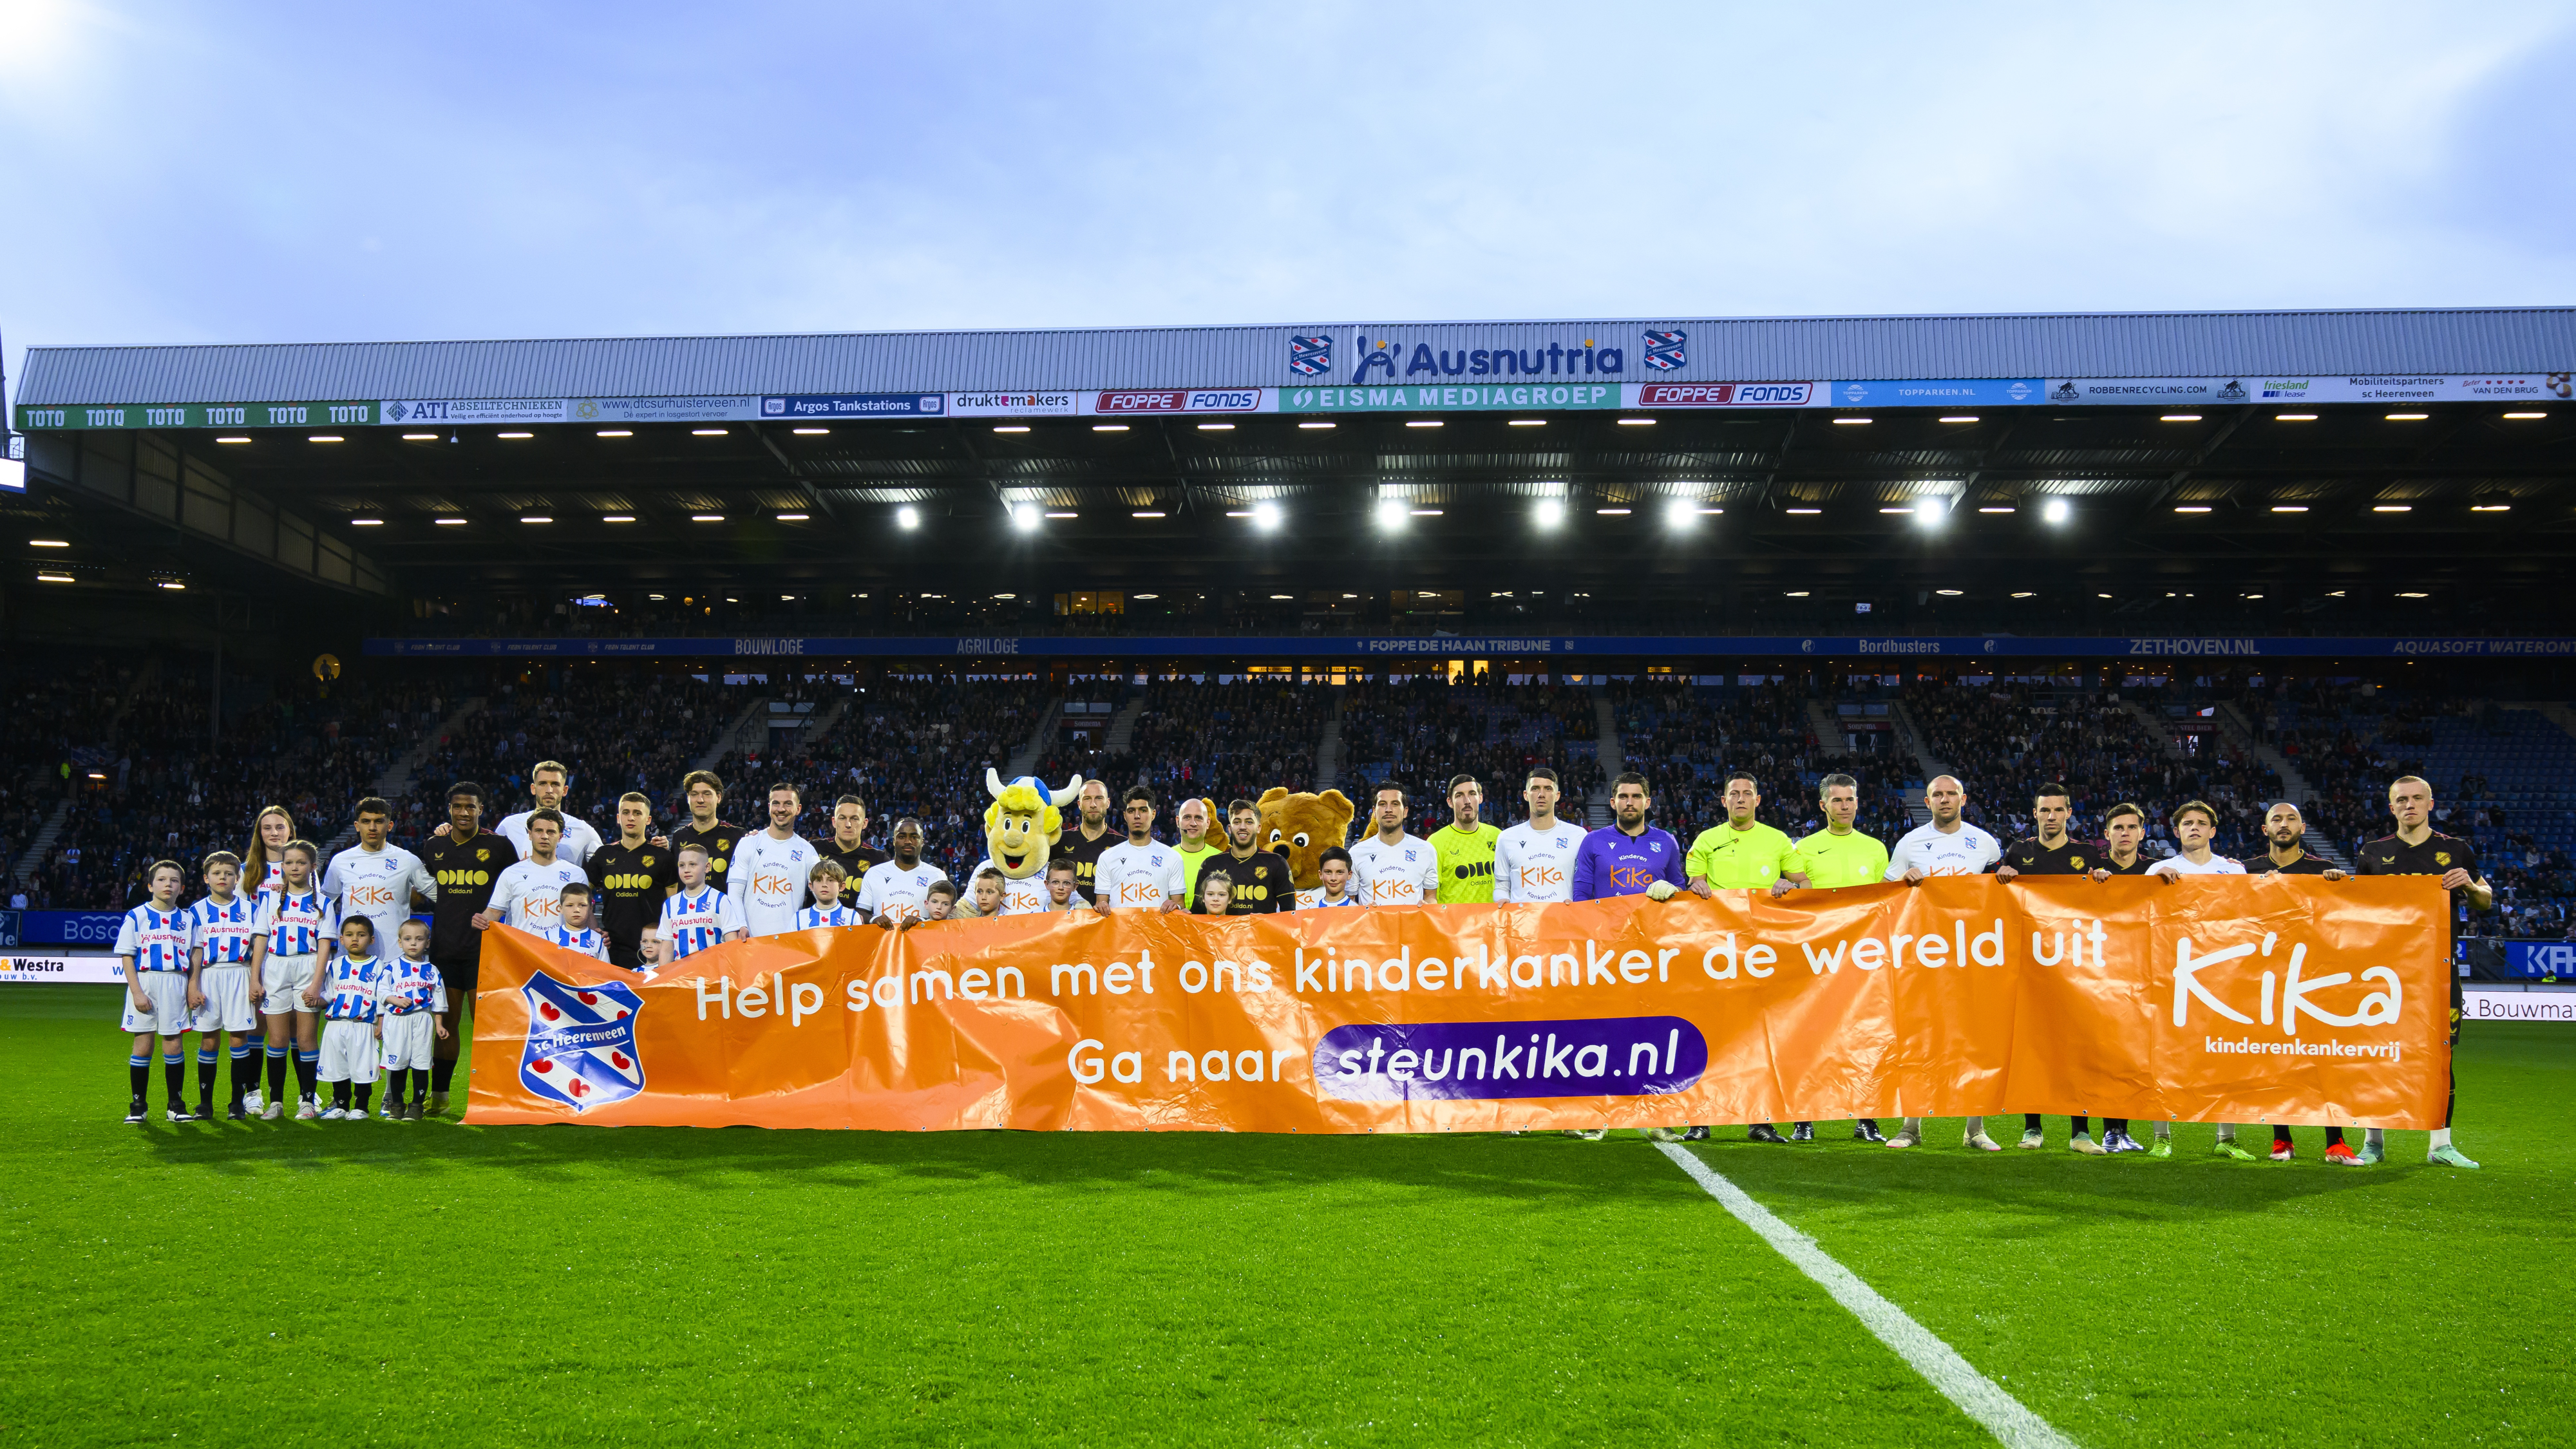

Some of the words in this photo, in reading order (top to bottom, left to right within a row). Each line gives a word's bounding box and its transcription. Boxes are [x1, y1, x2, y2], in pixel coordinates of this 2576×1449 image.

[1406, 339, 1623, 375] Ausnutria
[2264, 379, 2309, 390] friesland
[2350, 377, 2445, 387] Mobiliteitspartners
[1653, 388, 1721, 402] FOPPE
[1739, 387, 1804, 401] FONDS
[2089, 386, 2207, 394] ROBBENRECYCLING.COM
[2376, 390, 2434, 398] Heerenveen
[602, 397, 750, 409] www.dtcsurhuisterveen.nl
[1109, 395, 1173, 409] FOPPE
[1192, 393, 1253, 408] FONDS
[1320, 388, 1408, 408] EISMA
[1419, 386, 1606, 406] MEDIAGROEP
[412, 402, 449, 419] ATI
[451, 401, 563, 411] ABSEILTECHNIEKEN
[768, 401, 782, 412] Argos
[794, 401, 829, 413] Argos
[833, 400, 911, 412] Tankstations
[923, 399, 937, 410] Argos
[26, 410, 65, 426] TOTO
[86, 409, 125, 426] TOTO
[146, 408, 185, 425] TOTO
[206, 407, 245, 424] TOTO
[269, 406, 307, 424] TOTO
[329, 405, 368, 423] TOTO
[667, 411, 700, 419] losgestort
[735, 639, 804, 655] BOUWLOGE
[956, 638, 1019, 654] AGRILOGE
[1370, 639, 1416, 651] FOPPE
[1419, 639, 1439, 651] DE
[1442, 639, 1485, 651] HAAN
[1488, 639, 1551, 651] TRIBUNE
[1859, 639, 1940, 653] Bordbusters
[2130, 639, 2260, 654] ZETHOVEN.NL
[2393, 641, 2485, 654] AQUASOFT
[1528, 852, 1556, 861] Kinderen
[1618, 853, 1648, 863] Kinderen
[1937, 852, 1966, 860] Kinderen
[762, 862, 788, 871] Kinderen
[1379, 865, 1405, 875] Kinderen
[1126, 869, 1153, 878] Kinderen
[531, 884, 559, 893] Kinderen
[1006, 880, 1032, 888] Kinderen
[1526, 890, 1558, 901] Kankervrij
[757, 897, 787, 909] Kankervrij
[279, 915, 317, 926] Ausnutria
[529, 922, 560, 931] Kankervrij
[678, 916, 713, 926] Ausnutria
[210, 926, 249, 934] Ausnutria
[151, 933, 186, 945] Ausnutria
[13, 958, 64, 972] Westra
[22, 972, 37, 980] b.v.
[696, 972, 824, 1028] Help
[847, 965, 1025, 1012] samen
[1050, 949, 1154, 996] met
[1179, 959, 1273, 995] ons
[1294, 939, 1680, 994] kinderkanker
[1703, 933, 1777, 979] de
[1802, 918, 2004, 975] wereld
[2032, 919, 2107, 967] uit
[340, 984, 373, 996] Ausnutria
[2479, 999, 2576, 1018] Bouwma
[535, 1041, 549, 1054] sc
[553, 1026, 627, 1048] Heerenveen
[2205, 1036, 2401, 1063] kinderenkankervrij
[1068, 1038, 1142, 1084] Ga
[1168, 1047, 1293, 1083] naar
[1336, 1028, 1680, 1083] steunkika.nl
